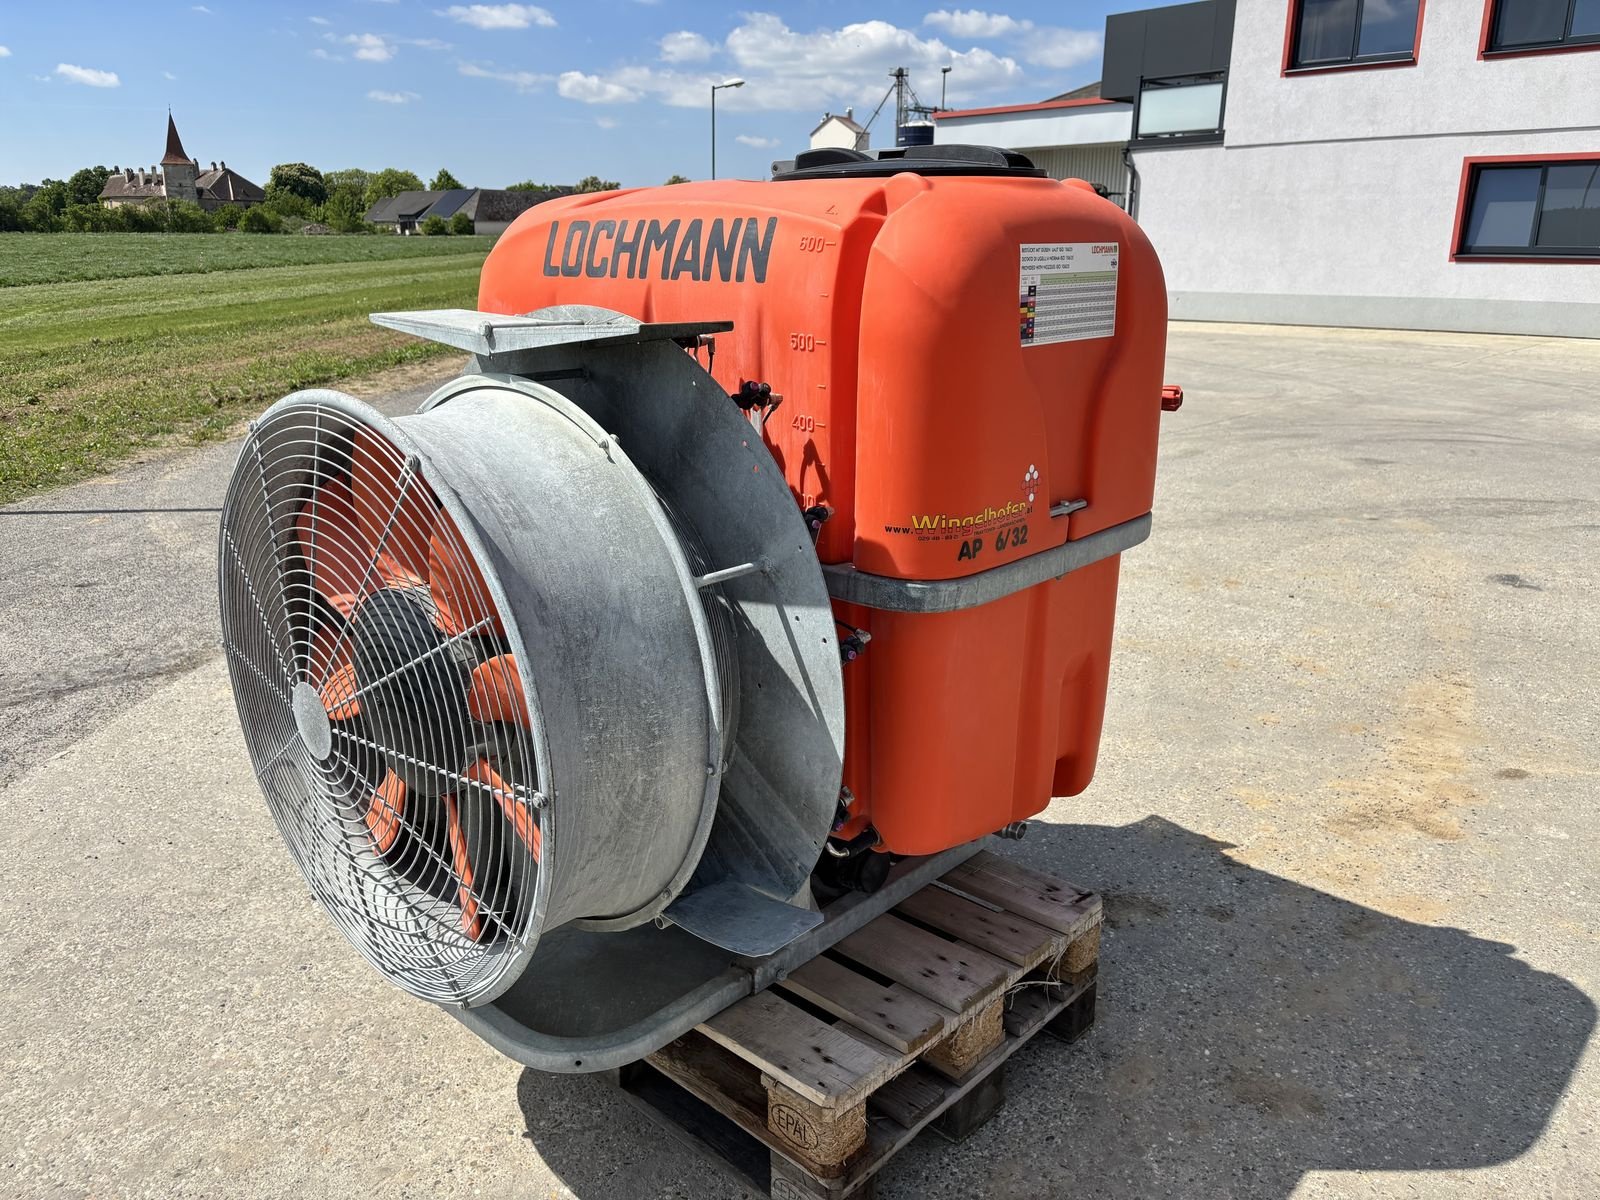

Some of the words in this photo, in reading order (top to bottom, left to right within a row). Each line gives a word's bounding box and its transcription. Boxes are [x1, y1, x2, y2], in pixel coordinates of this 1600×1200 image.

[543, 216, 778, 283] LOCHMANN
[800, 235, 825, 253] 600
[790, 332, 815, 352] 500
[792, 415, 815, 432] 400
[958, 538, 983, 561] AP
[995, 524, 1028, 552] 6/32
[777, 1109, 811, 1146] EPAL
